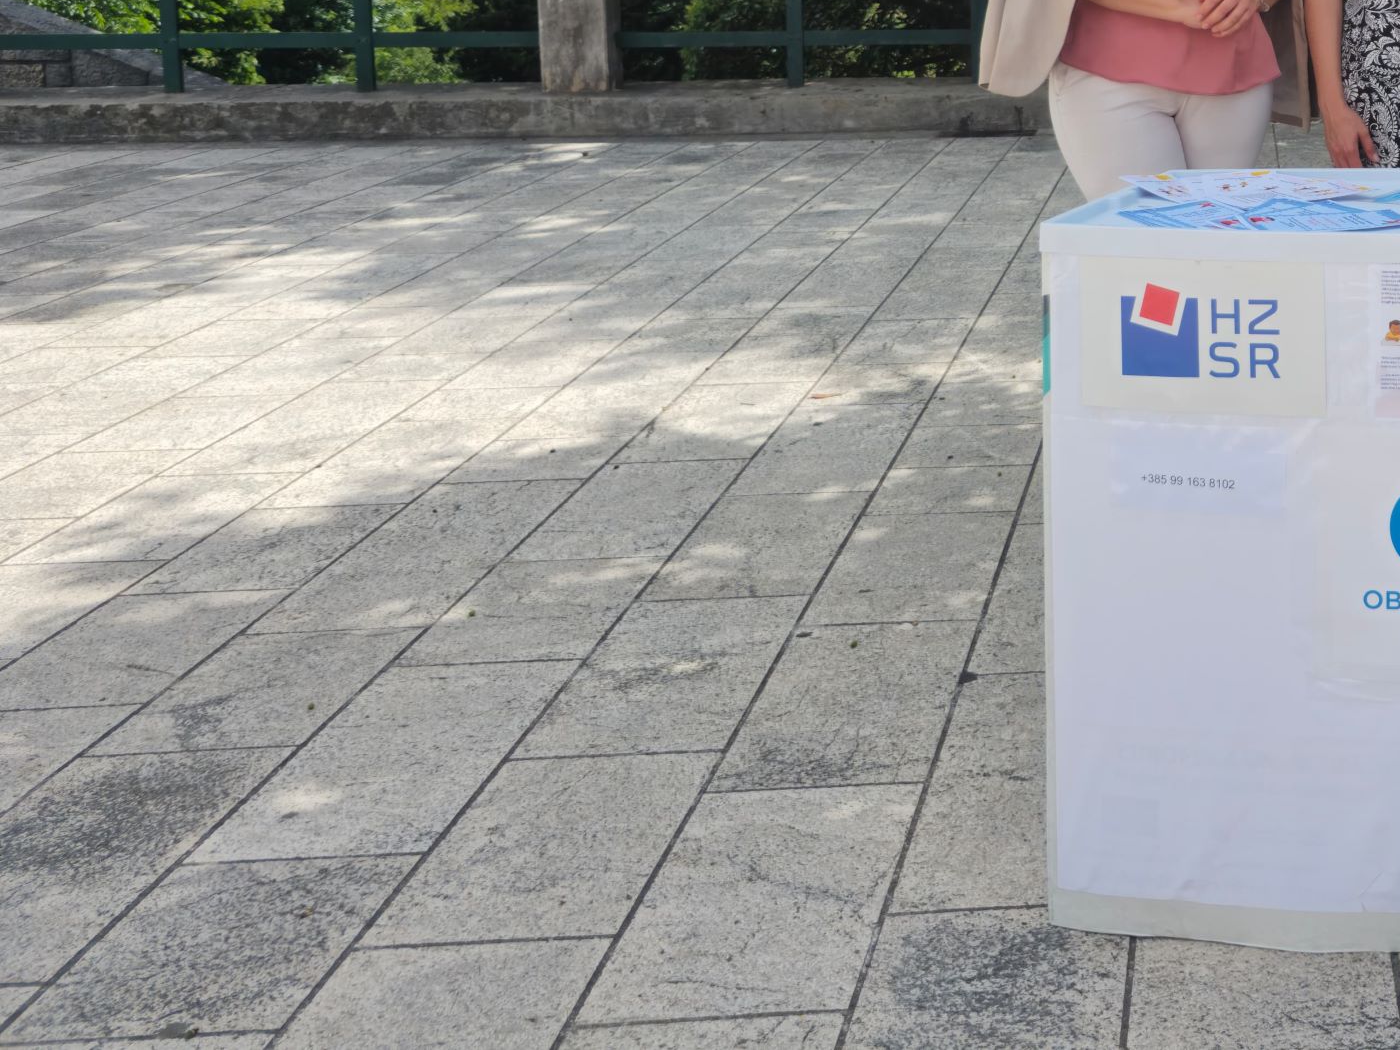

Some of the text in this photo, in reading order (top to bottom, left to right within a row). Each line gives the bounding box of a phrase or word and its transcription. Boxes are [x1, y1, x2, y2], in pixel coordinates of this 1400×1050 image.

[1210, 298, 1281, 335] HZ
[1209, 341, 1281, 379] SR
[1141, 473, 1236, 490] +385 99 163 8102
